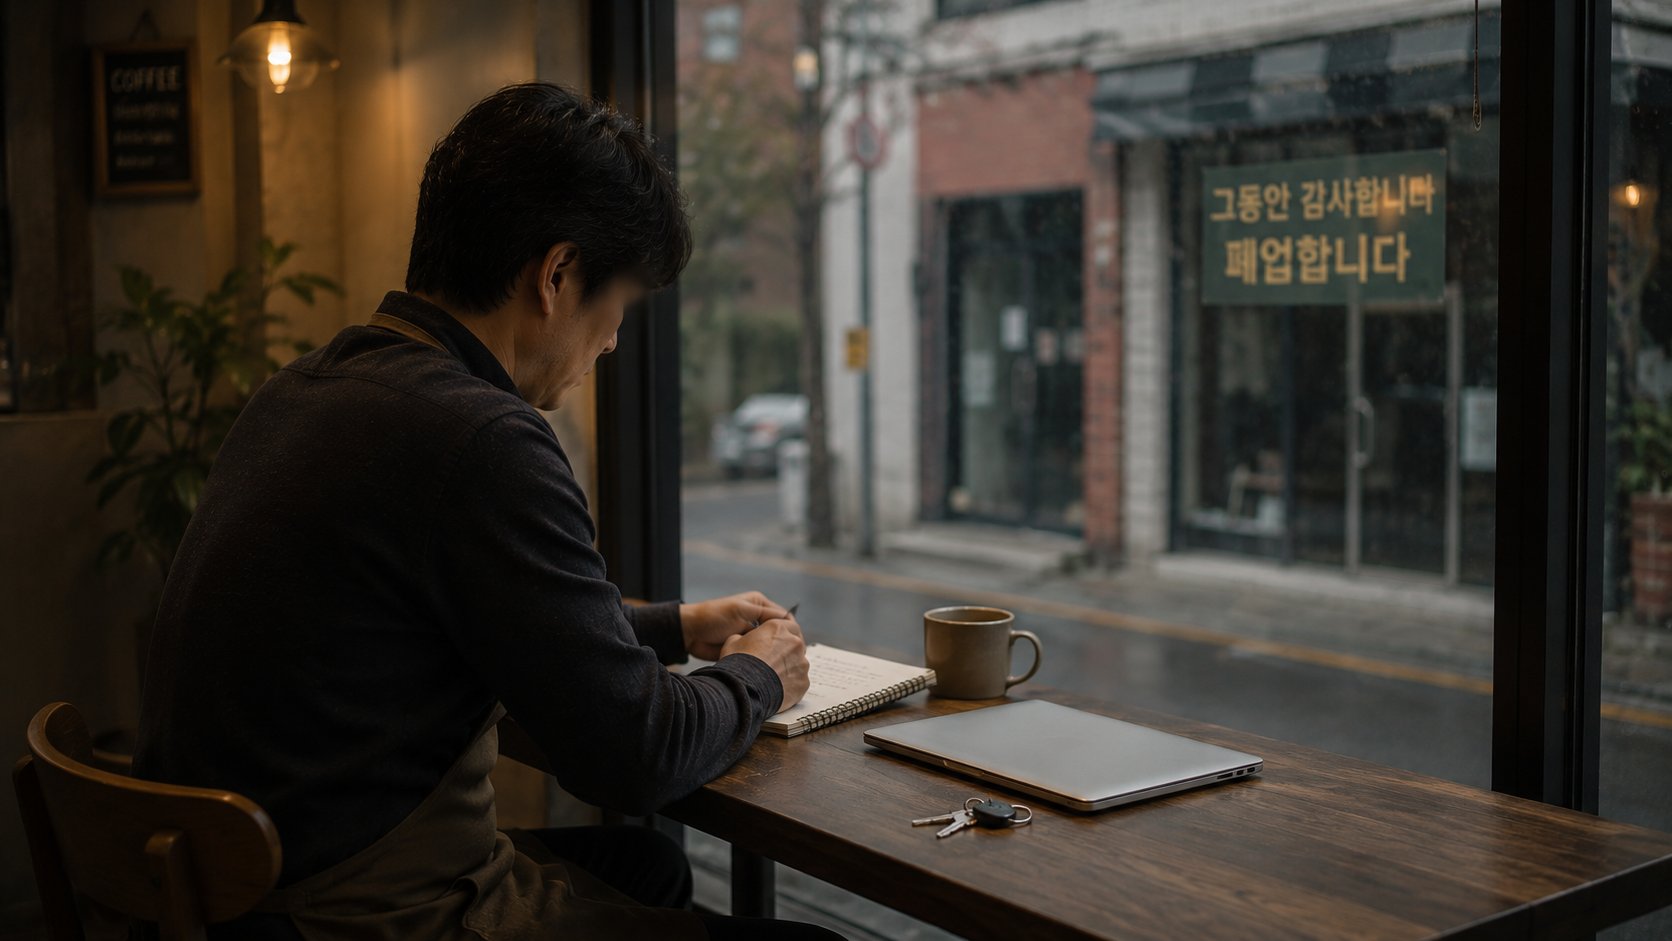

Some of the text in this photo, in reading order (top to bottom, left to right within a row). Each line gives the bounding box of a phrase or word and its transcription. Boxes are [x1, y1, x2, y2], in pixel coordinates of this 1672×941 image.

[111, 66, 180, 92] COFFEE
[1210, 174, 1435, 222] 그동안 감사합니다
[1225, 232, 1410, 285] 폐업합니다
